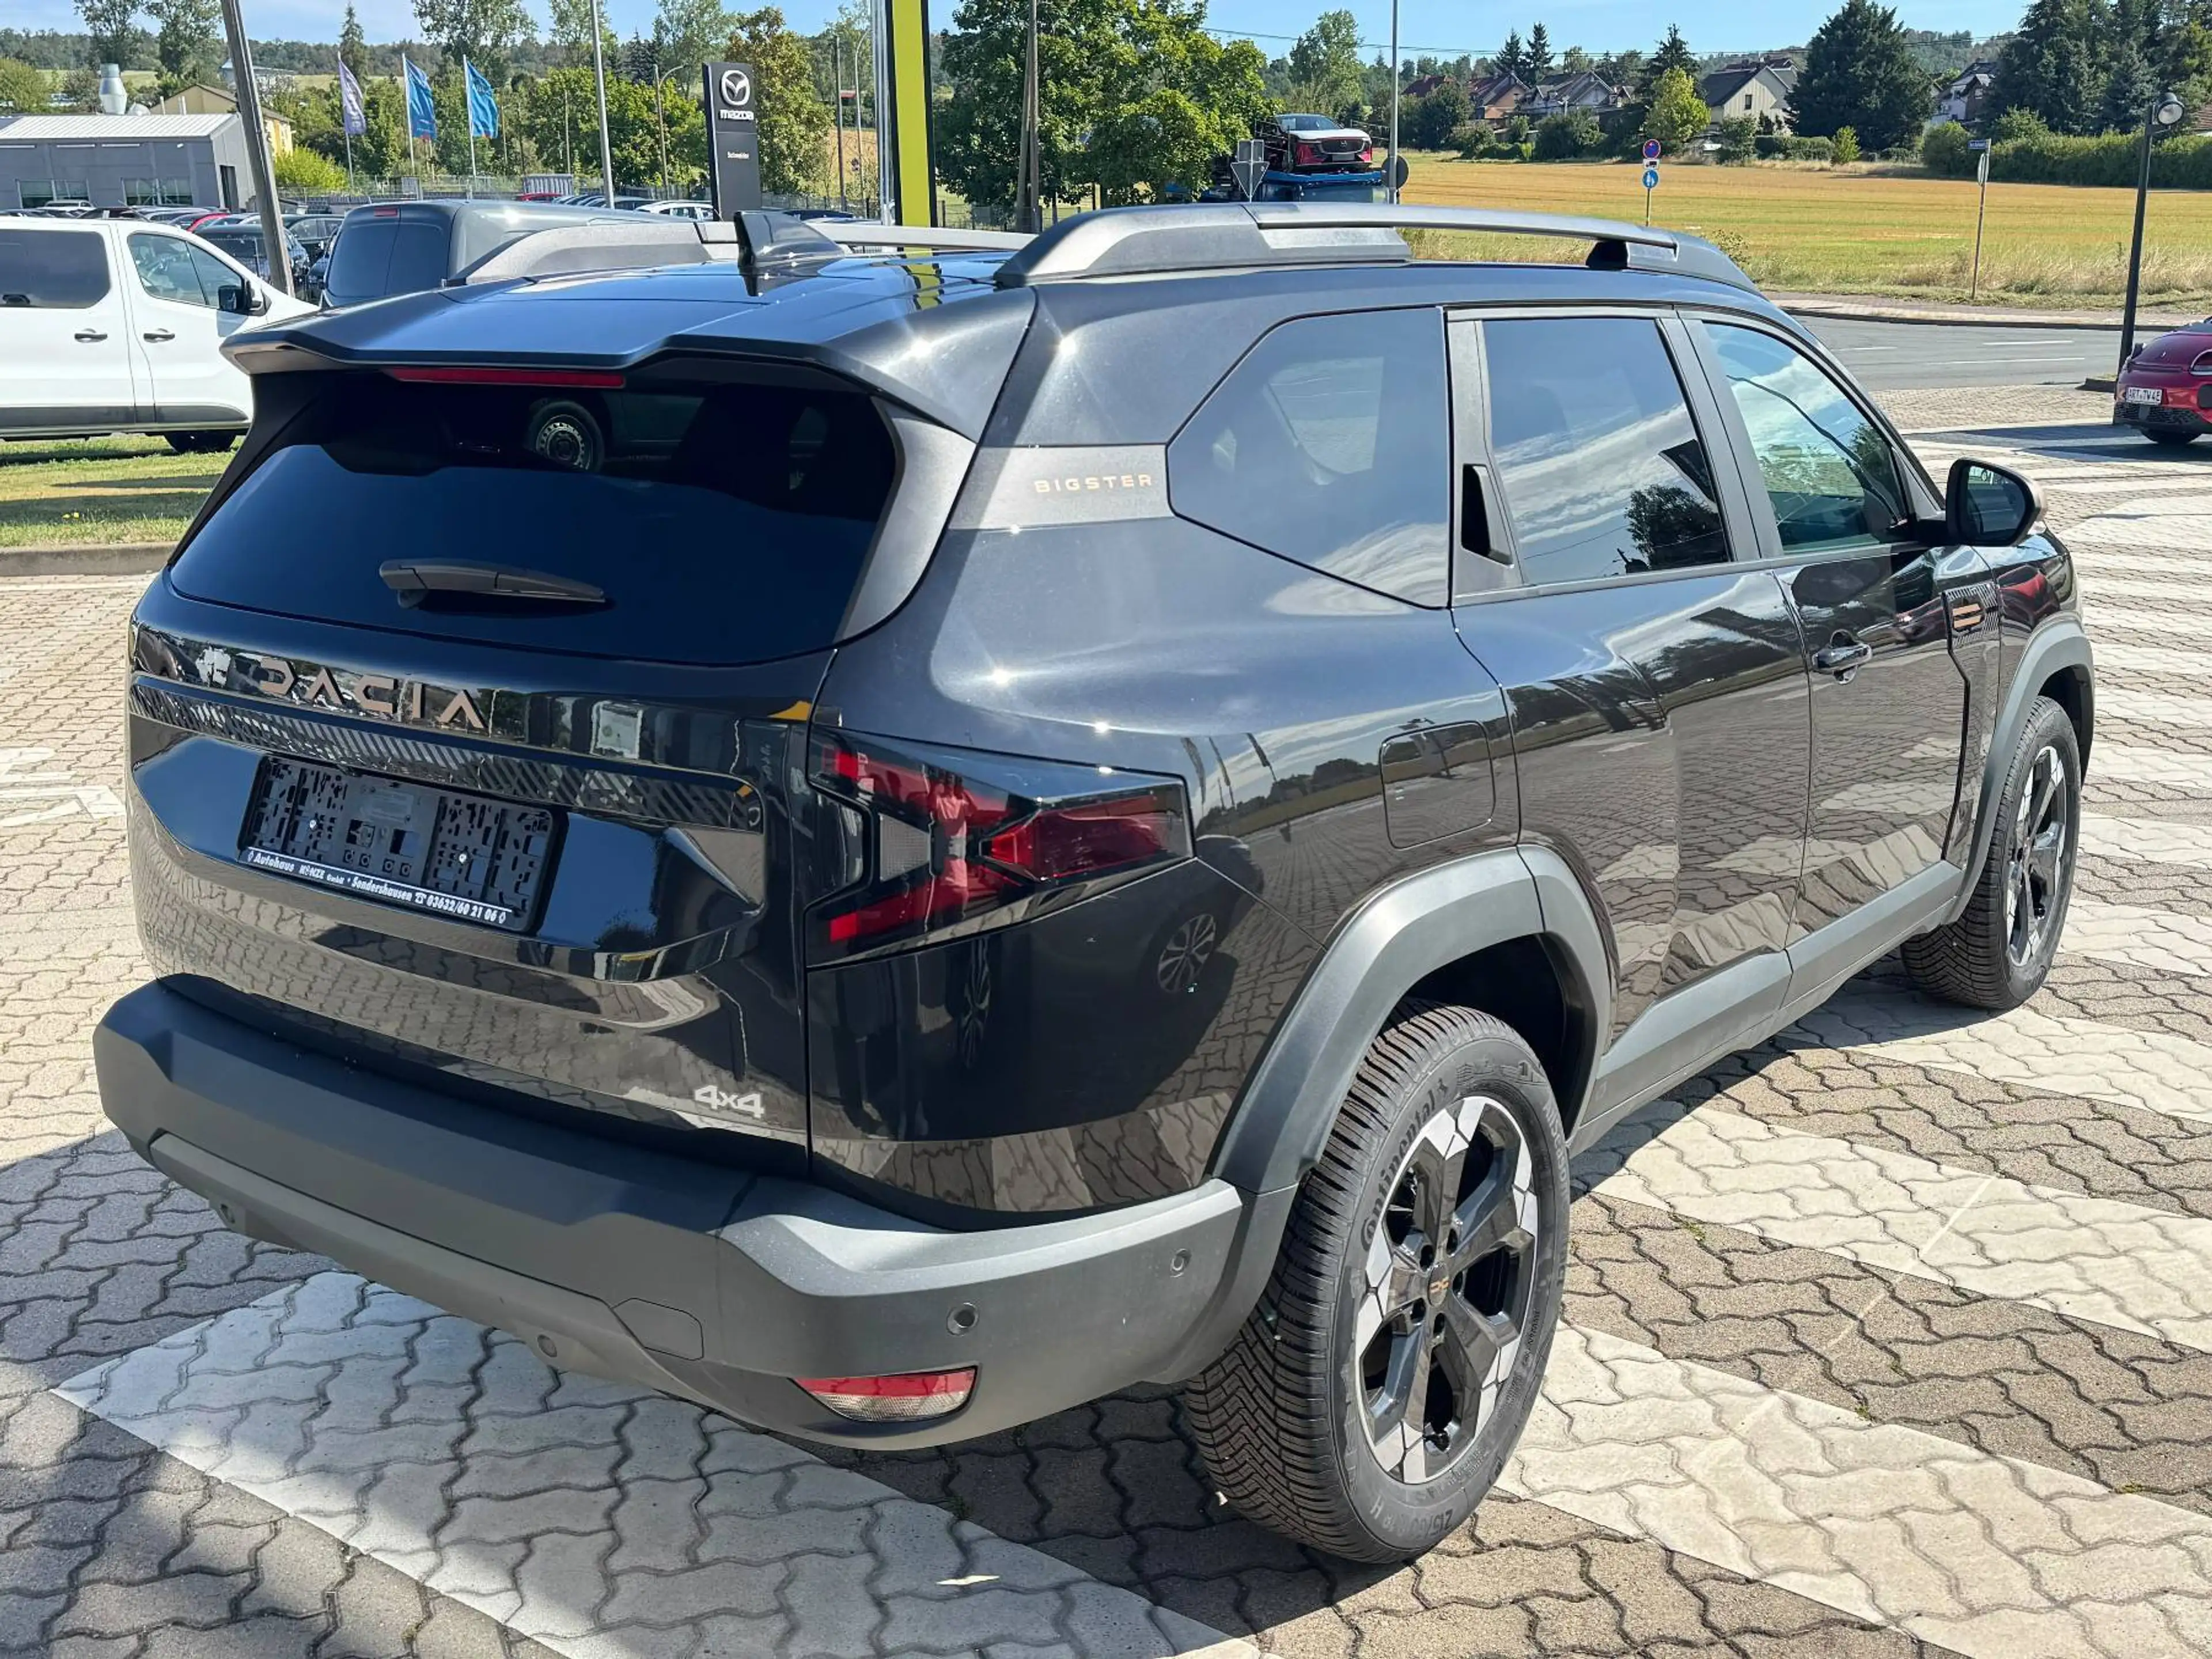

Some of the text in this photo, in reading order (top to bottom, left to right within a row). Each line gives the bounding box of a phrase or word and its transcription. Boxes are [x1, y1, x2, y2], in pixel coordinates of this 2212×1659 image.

[1034, 474, 1152, 493] BIGSTER
[259, 657, 485, 729] DACIA
[253, 852, 295, 873] Autohaus
[351, 876, 413, 902] Sondershausen
[426, 895, 470, 915] 03632/60
[469, 906, 482, 918] 21
[484, 909, 497, 922] 06
[694, 1085, 764, 1119] 4x4
[1361, 1088, 1437, 1252] Continental
